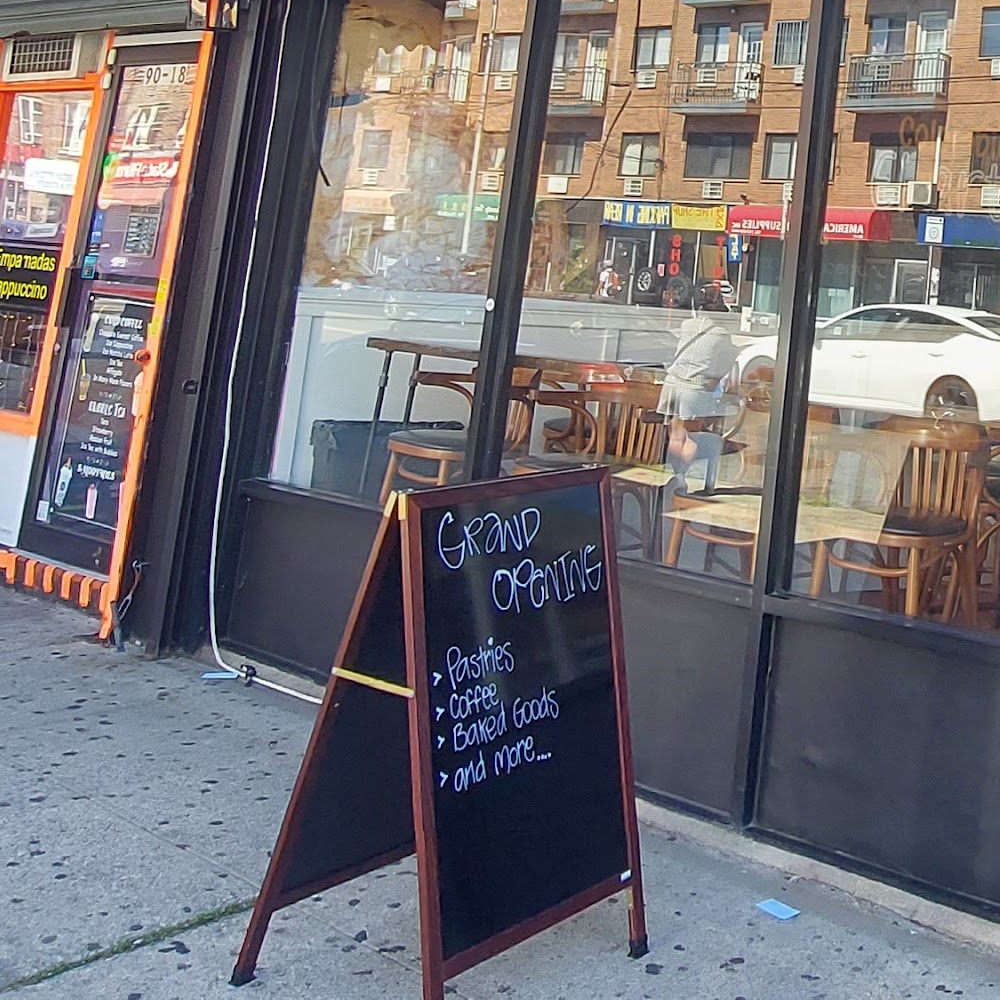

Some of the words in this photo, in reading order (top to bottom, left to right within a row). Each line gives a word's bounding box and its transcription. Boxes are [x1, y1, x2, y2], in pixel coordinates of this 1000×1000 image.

[145, 64, 187, 85] 90-18
[446, 637, 515, 691] Pastries
[453, 700, 508, 752] Baked
[512, 685, 560, 729] Goods
[453, 749, 487, 793] and
